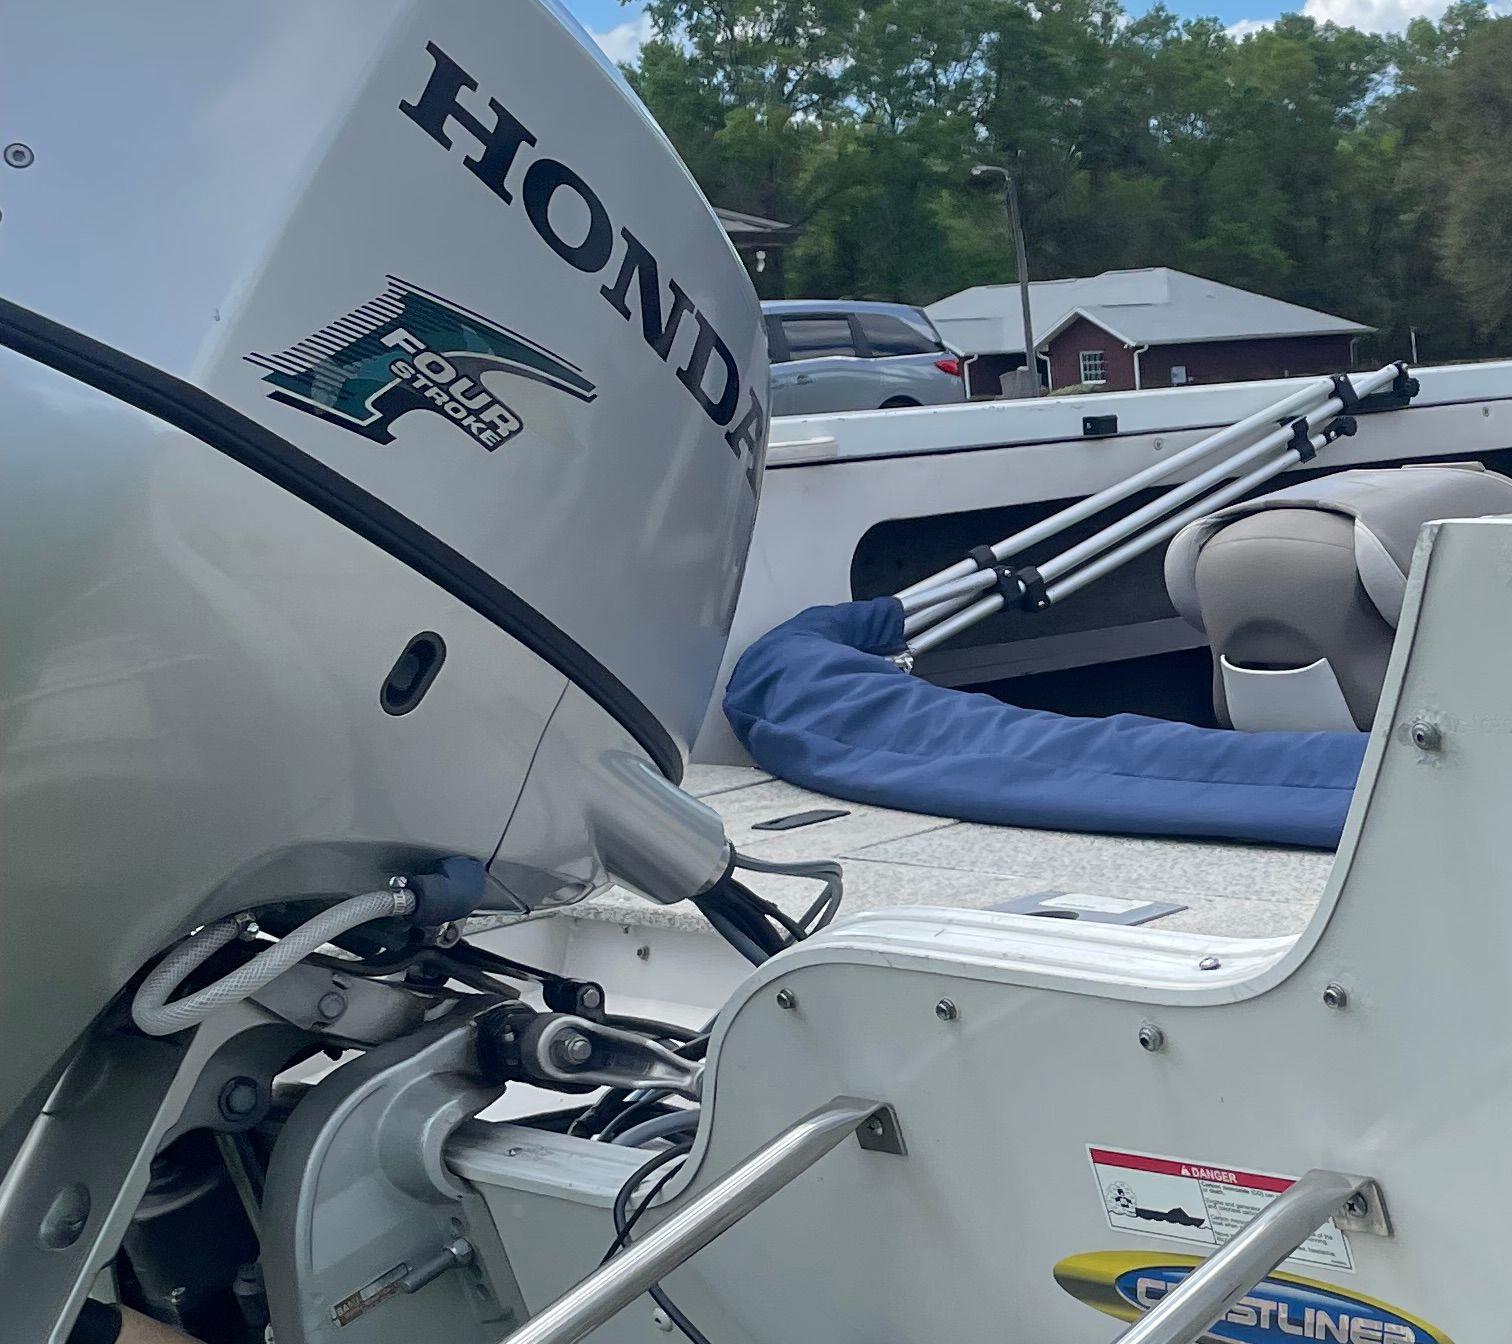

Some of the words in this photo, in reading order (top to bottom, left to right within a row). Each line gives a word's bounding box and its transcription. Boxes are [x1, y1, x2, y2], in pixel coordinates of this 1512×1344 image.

[380, 327, 521, 439] FOUR
[389, 359, 503, 448] STROKE
[1190, 1166, 1238, 1184] DANGER
